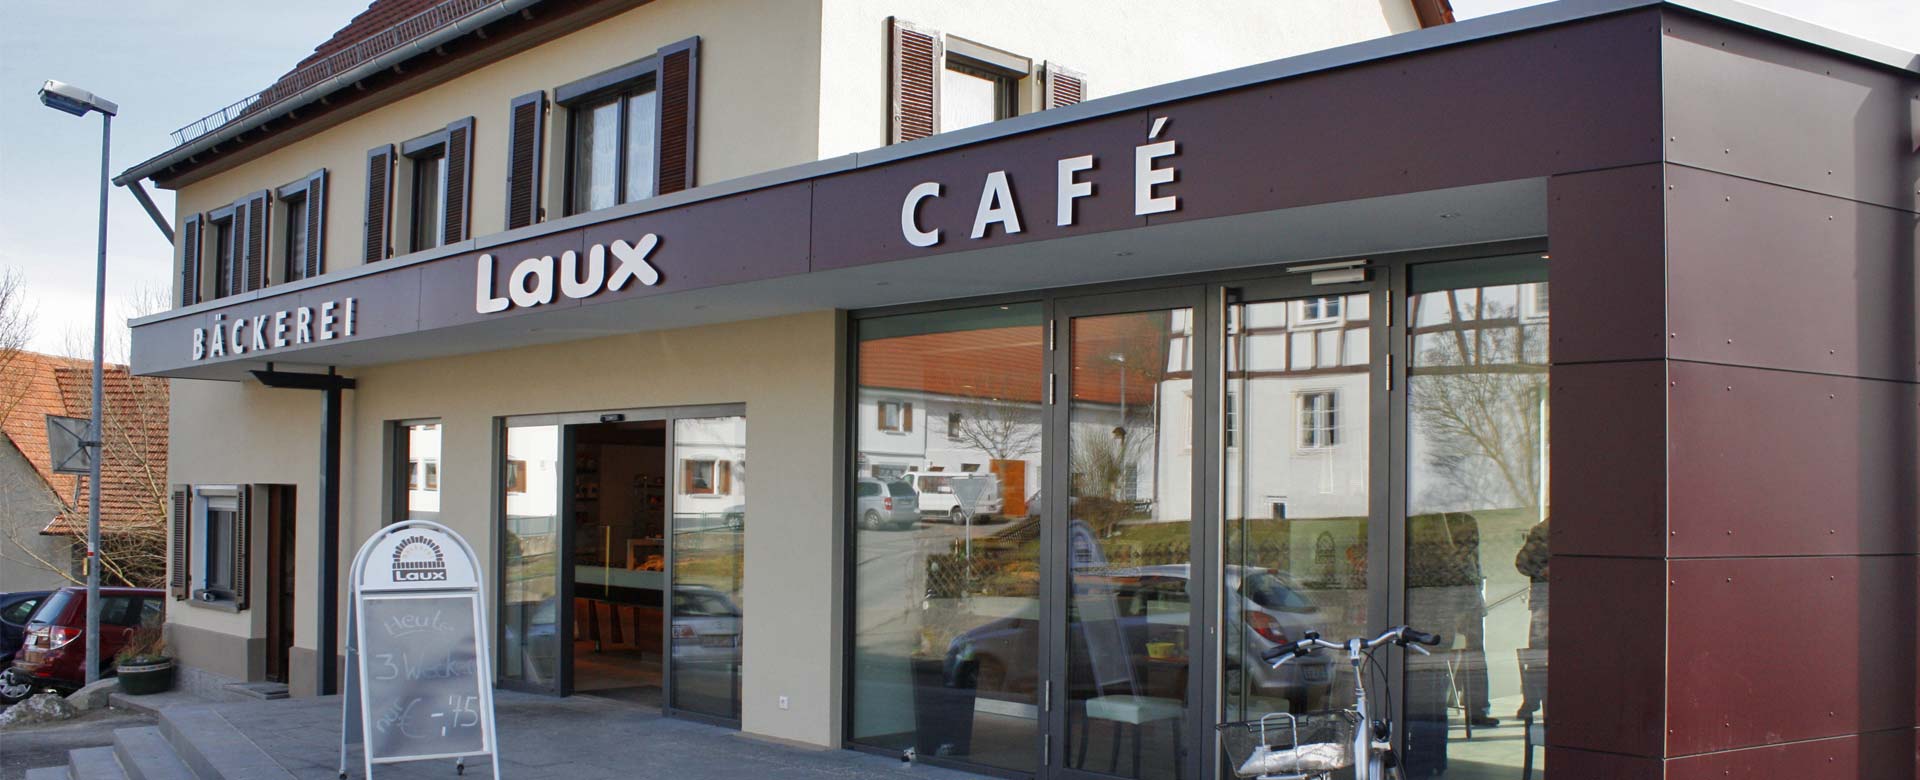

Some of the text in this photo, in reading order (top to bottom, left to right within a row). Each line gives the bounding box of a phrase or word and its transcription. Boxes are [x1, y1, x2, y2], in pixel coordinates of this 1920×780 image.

[192, 116, 1177, 360] BÄCKEREI Laux CAFÉ
[396, 571, 446, 581] Laux
[375, 653, 399, 680] 3
